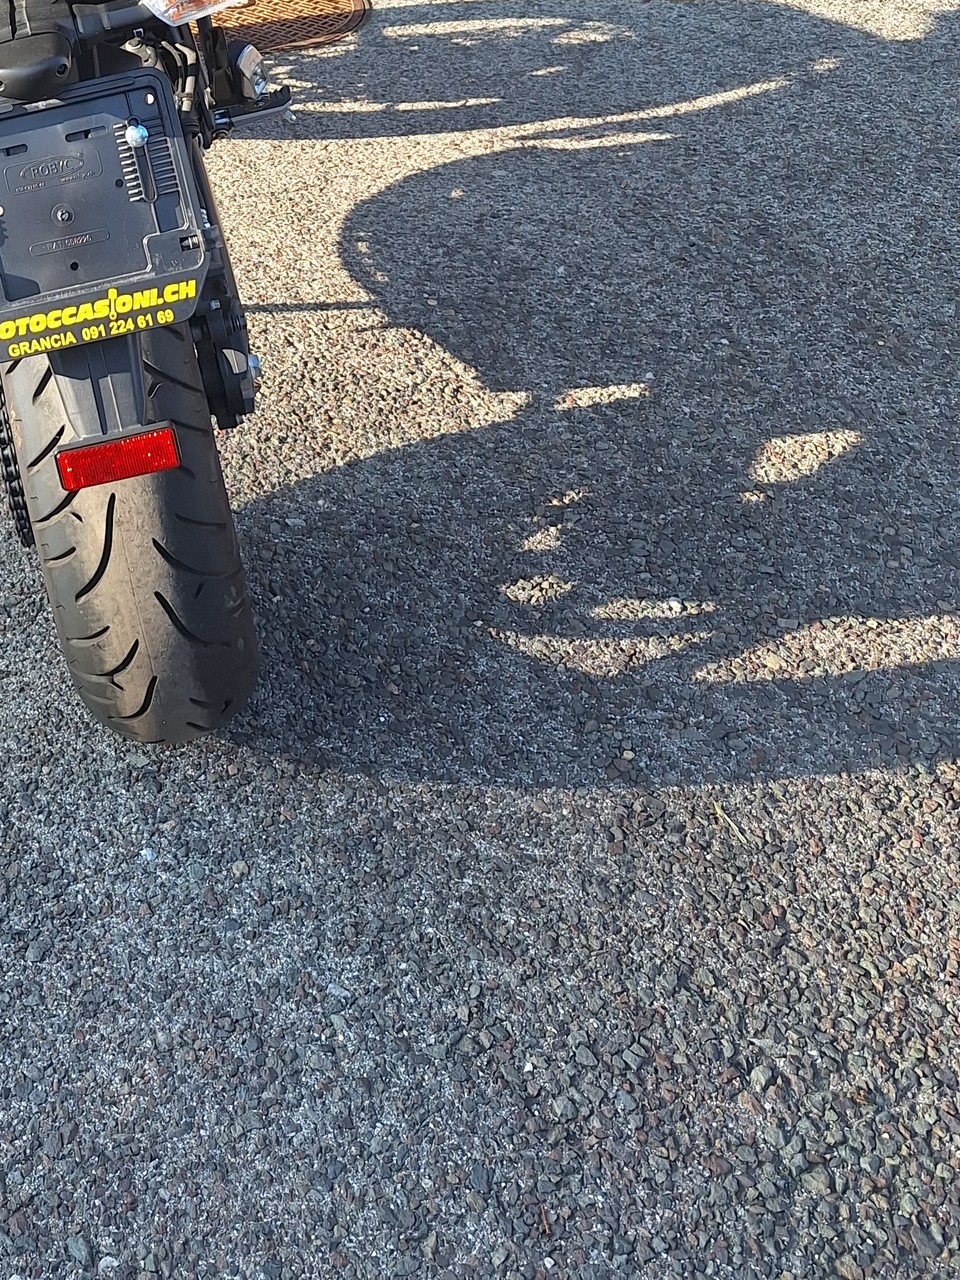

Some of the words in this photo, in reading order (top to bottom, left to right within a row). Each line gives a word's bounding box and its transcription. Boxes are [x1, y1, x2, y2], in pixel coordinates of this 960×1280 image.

[8, 332, 77, 358] GRANCIA
[81, 323, 106, 342] 091
[110, 316, 135, 336] 224
[138, 313, 154, 329] 61
[157, 308, 175, 323] 69
